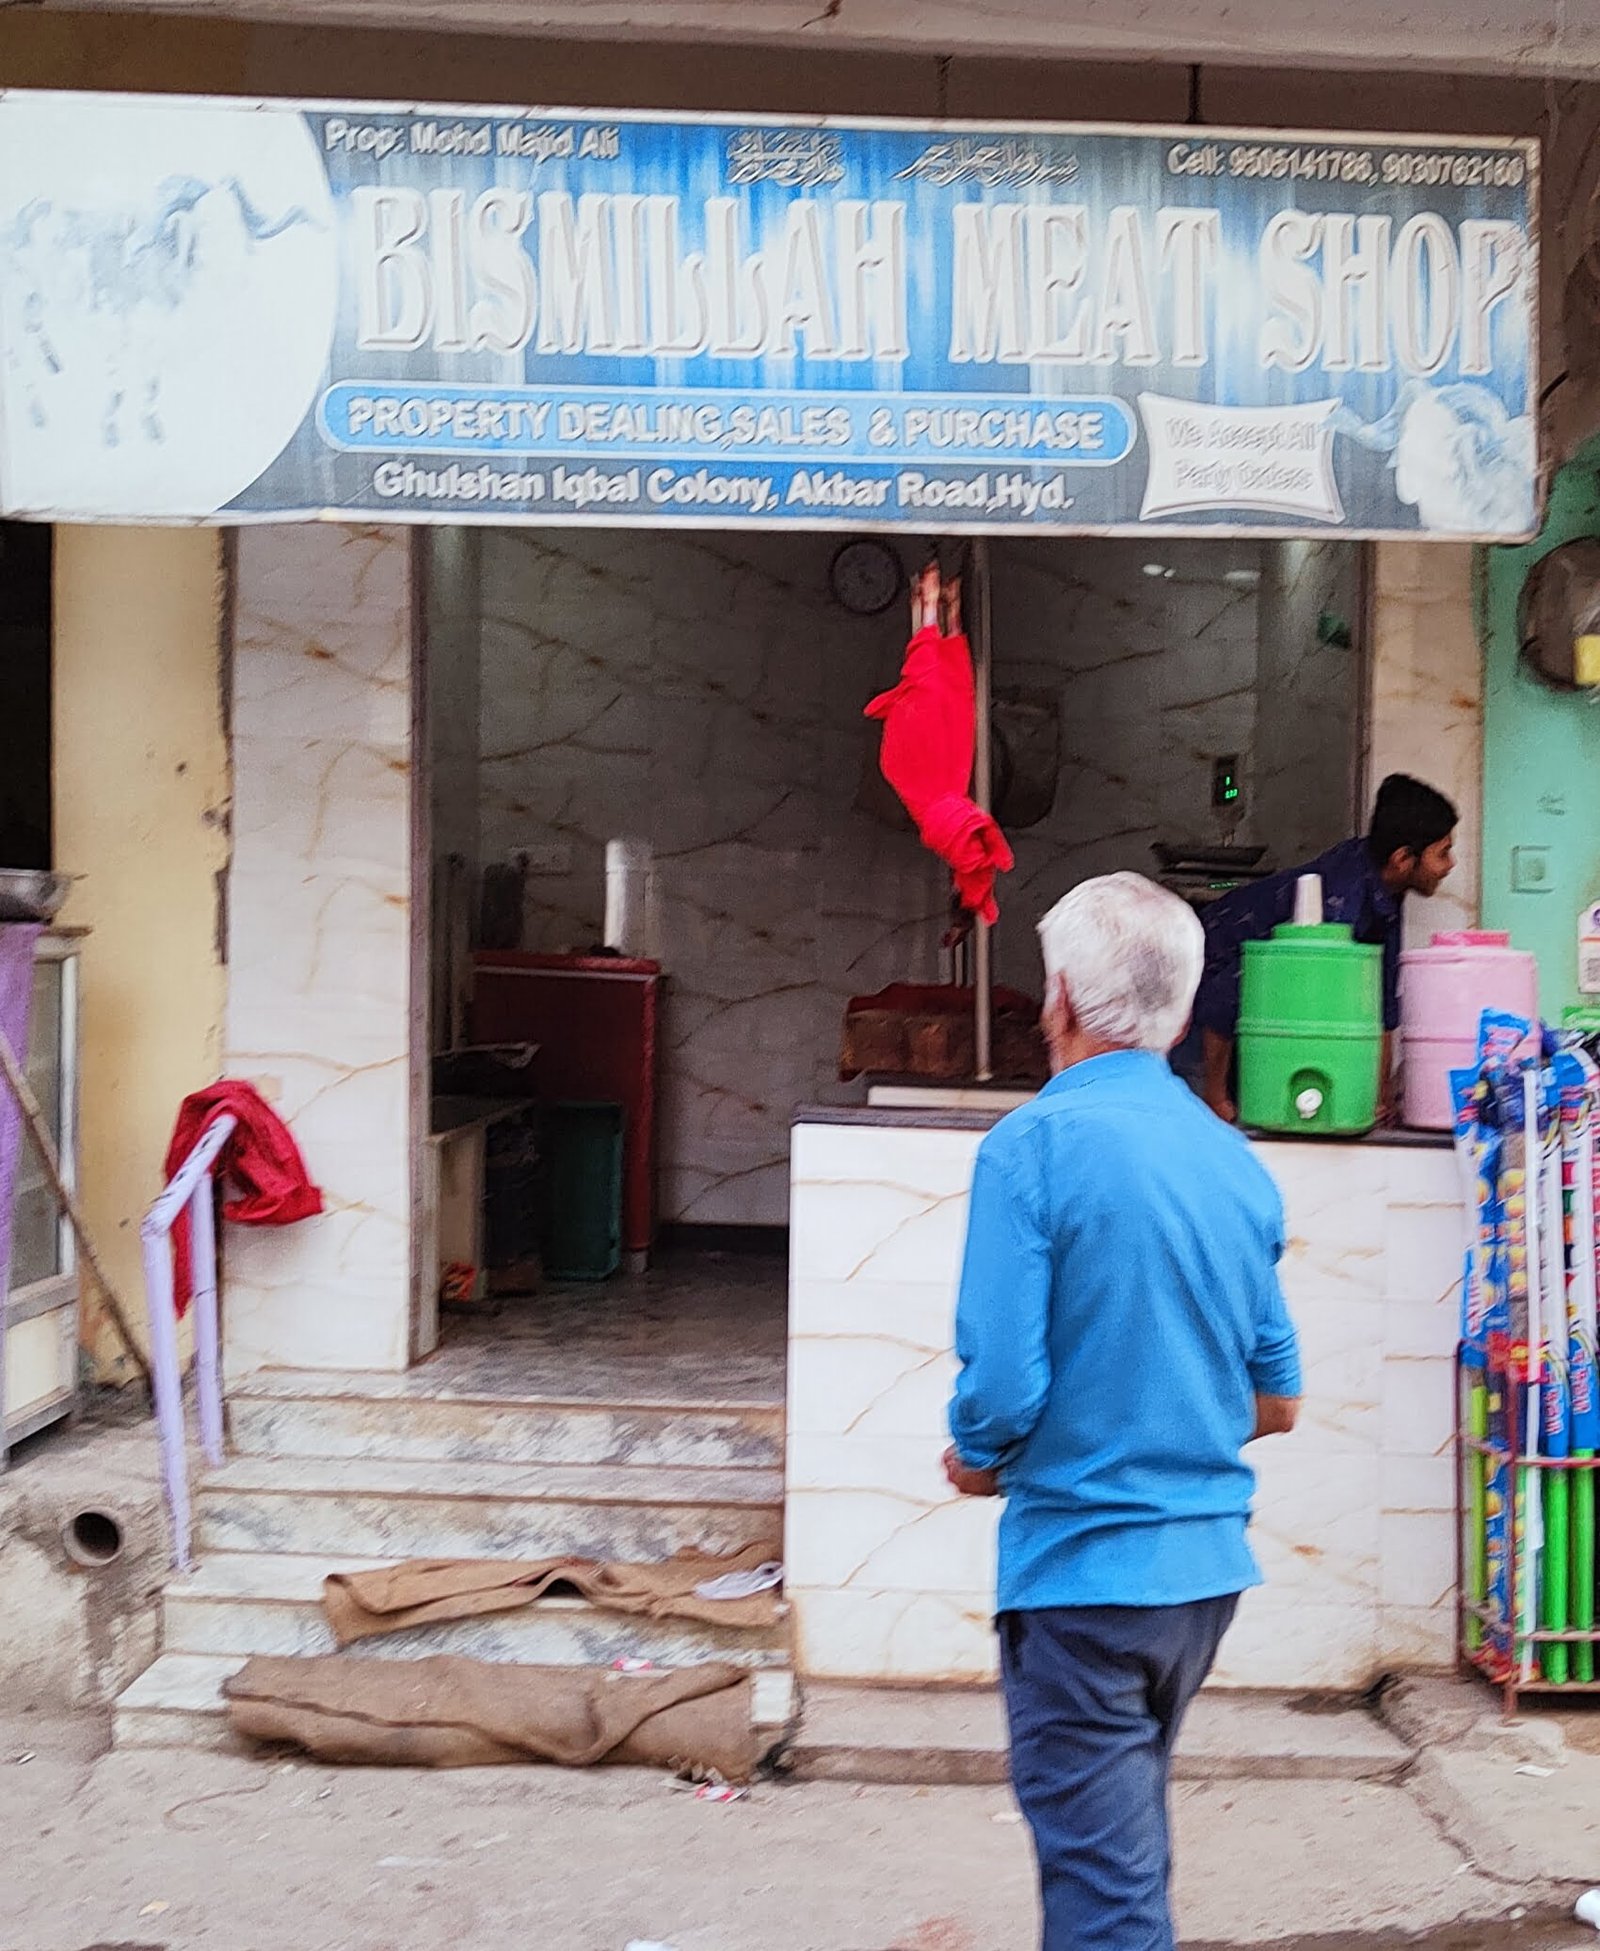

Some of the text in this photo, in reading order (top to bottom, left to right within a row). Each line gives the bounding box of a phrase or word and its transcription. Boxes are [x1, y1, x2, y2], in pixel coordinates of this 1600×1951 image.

[324, 118, 620, 164] Prop: Mohd Majid Ali
[1167, 143, 1226, 177] Cell:
[352, 186, 1530, 379] BISMILLAH MEAT SHOP
[347, 396, 553, 440] PROPERTY
[866, 406, 898, 448] &
[904, 408, 1104, 450] PURCHASE
[1166, 417, 1316, 456] We Accept All
[372, 460, 546, 502] Ghulshan
[552, 466, 640, 509] Iqbal
[645, 466, 780, 513] Colony,
[785, 470, 892, 508] Akbar
[1174, 458, 1233, 494] Party
